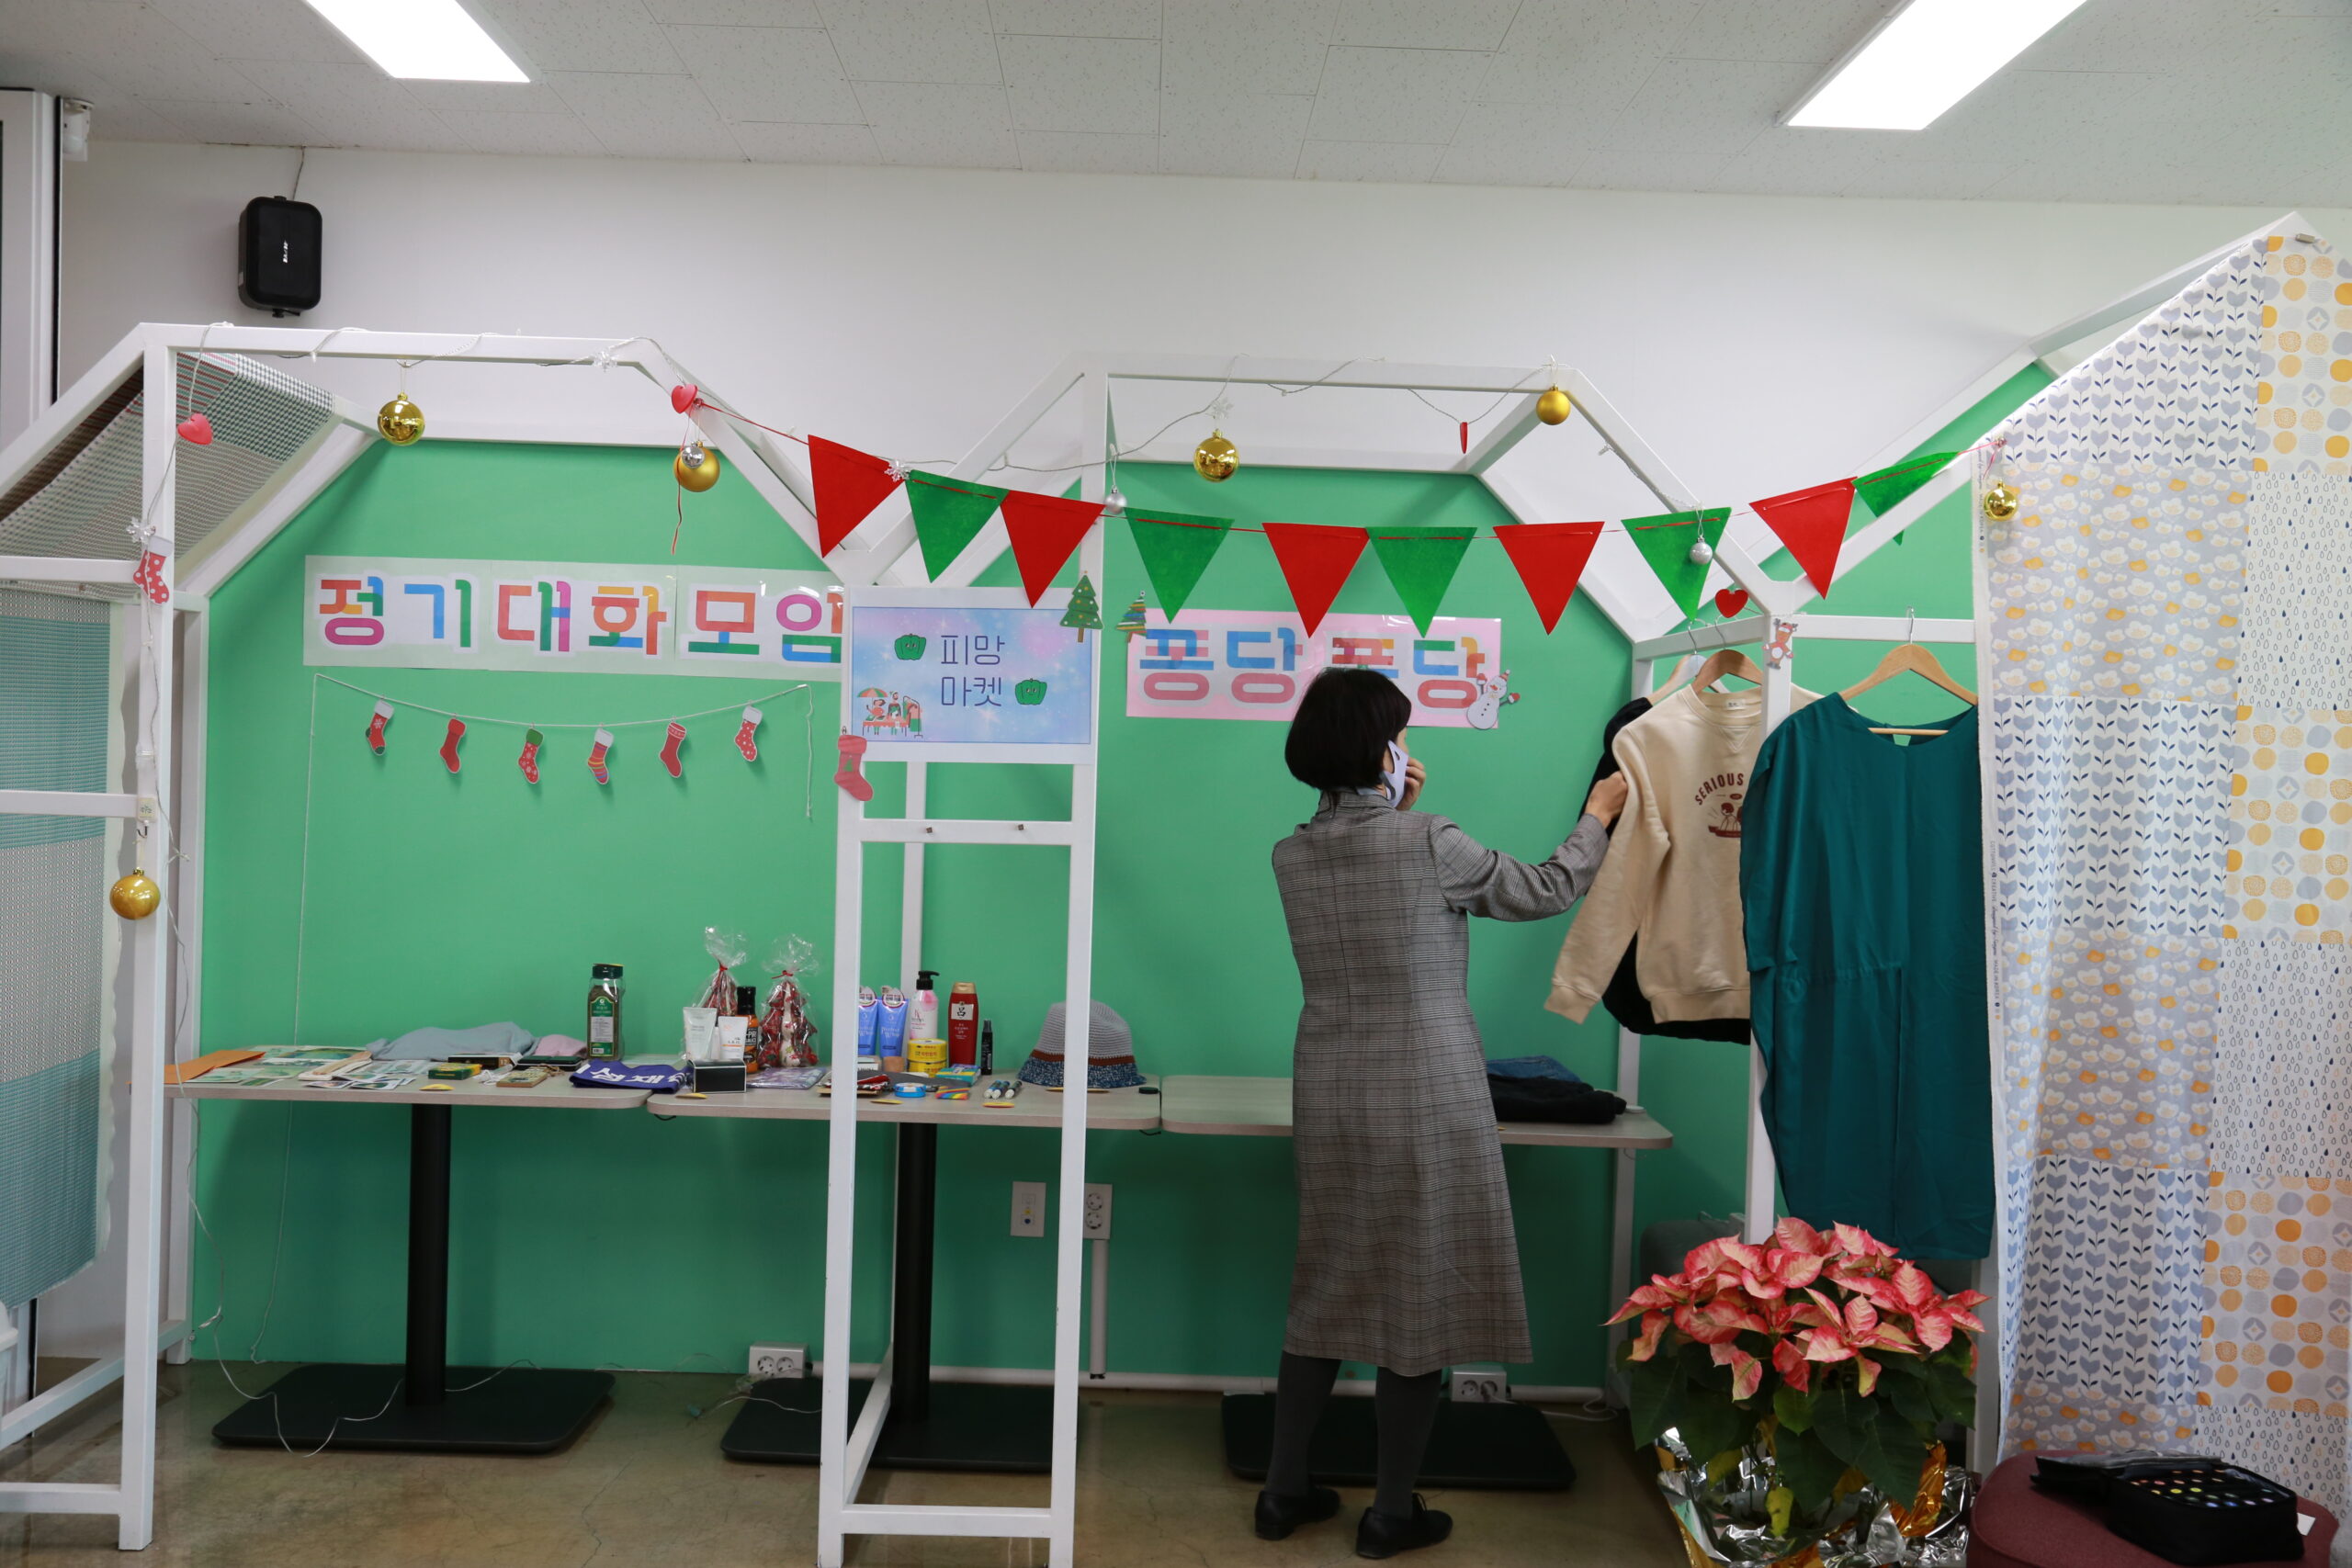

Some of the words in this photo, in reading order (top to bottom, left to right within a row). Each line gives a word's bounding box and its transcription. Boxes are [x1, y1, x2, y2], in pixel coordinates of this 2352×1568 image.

[941, 635, 1005, 666] 피망
[941, 676, 1001, 707] 마켓
[1695, 773, 1745, 806] SERIOUS
